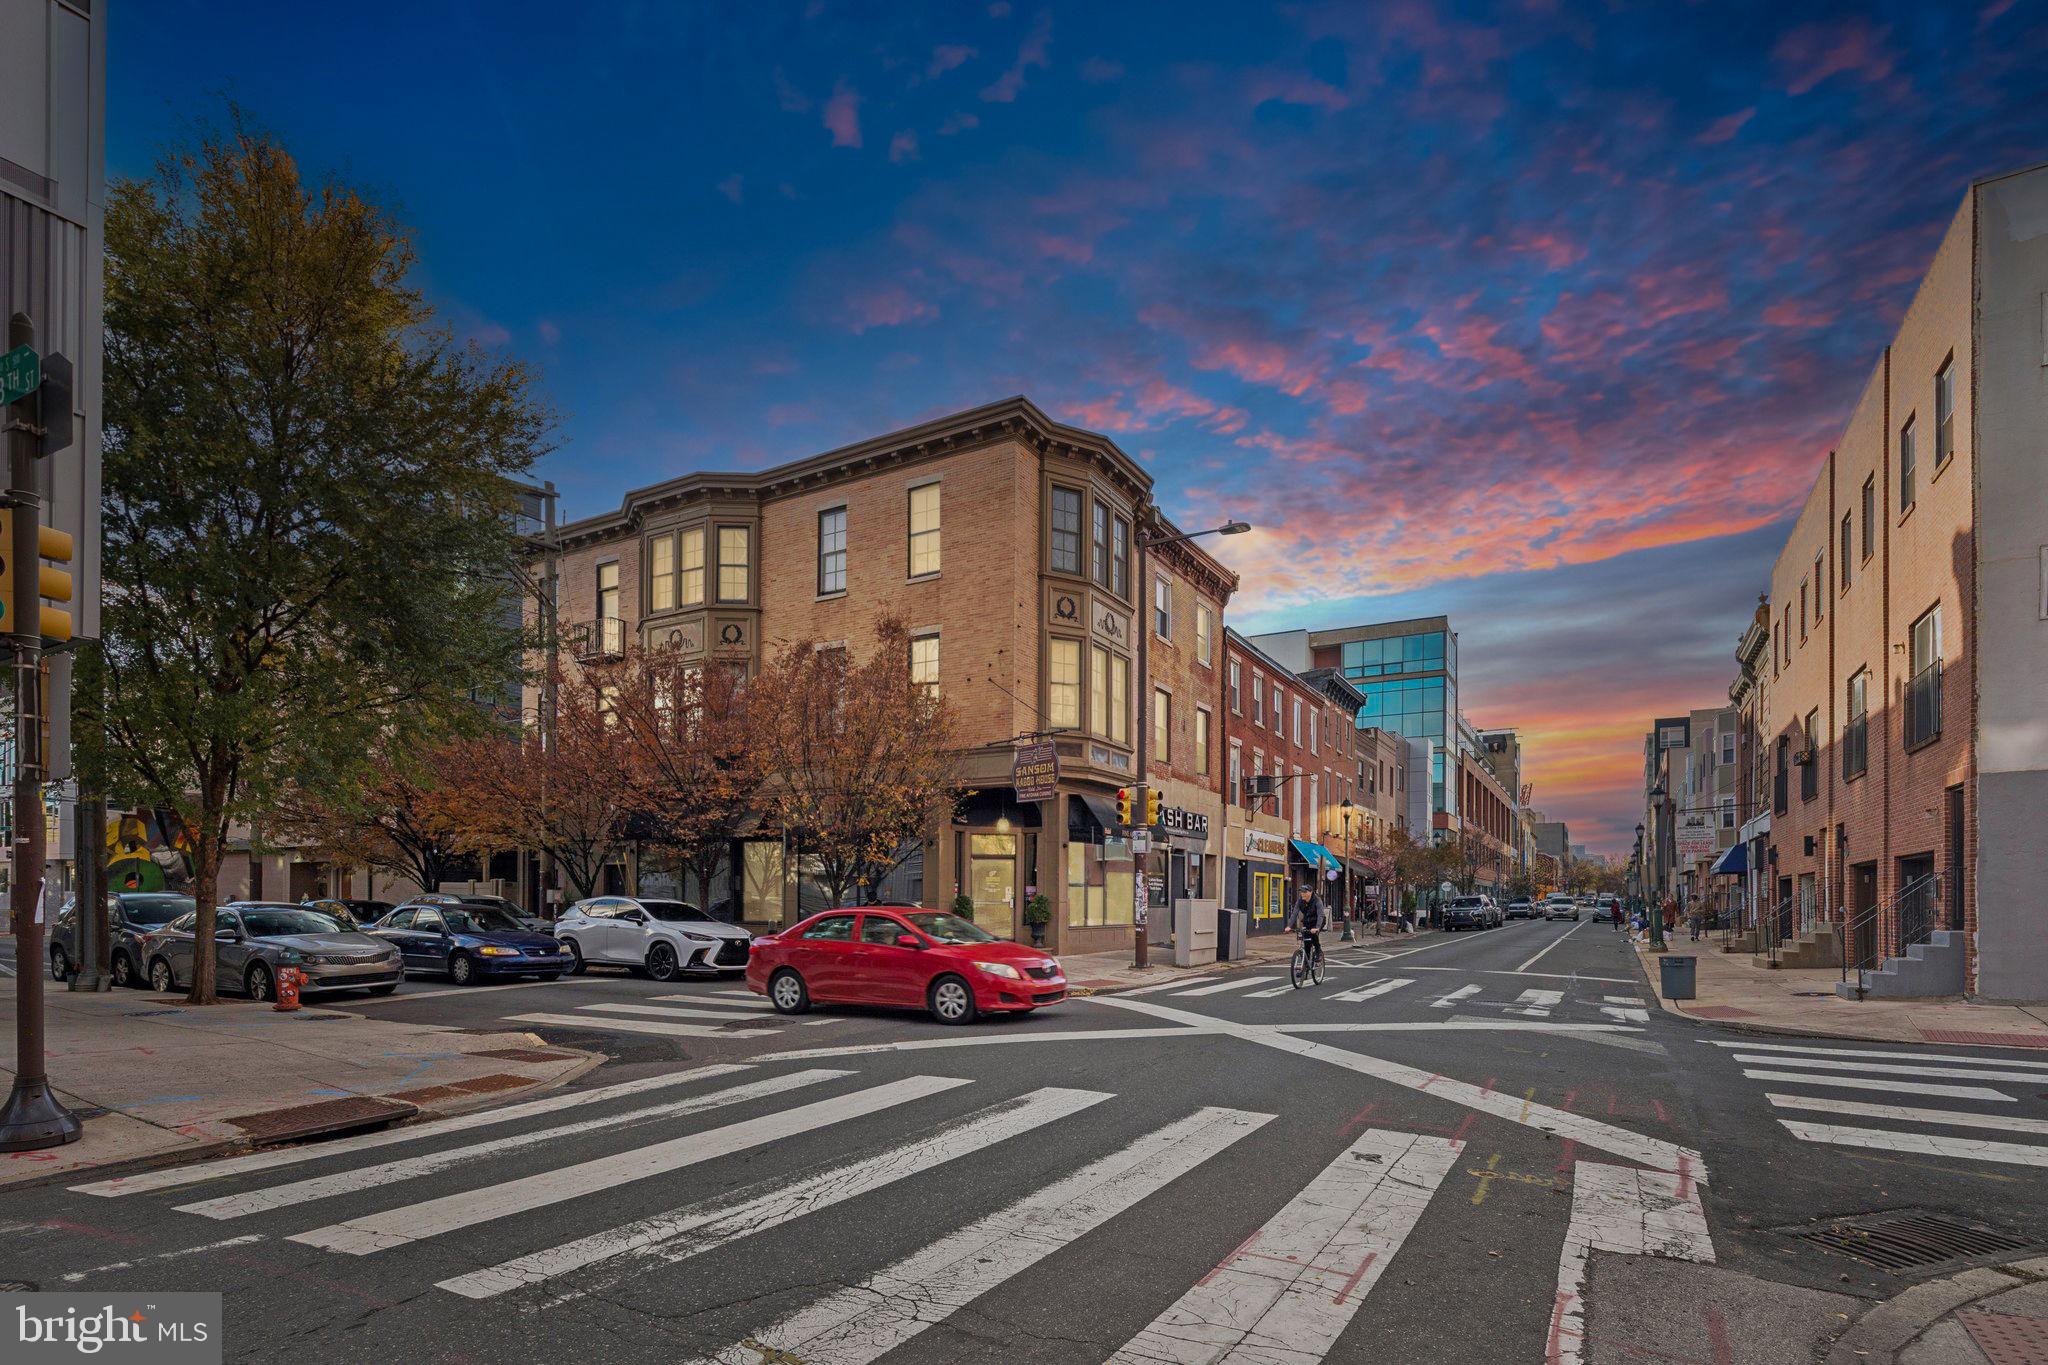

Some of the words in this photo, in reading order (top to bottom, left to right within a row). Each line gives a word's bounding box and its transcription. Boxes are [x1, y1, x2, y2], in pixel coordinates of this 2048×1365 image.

[25, 369, 34, 391] ST
[1016, 763, 1054, 776] SANSOM
[1036, 773, 1055, 785] HOUSE
[1186, 812, 1208, 833] BAR
